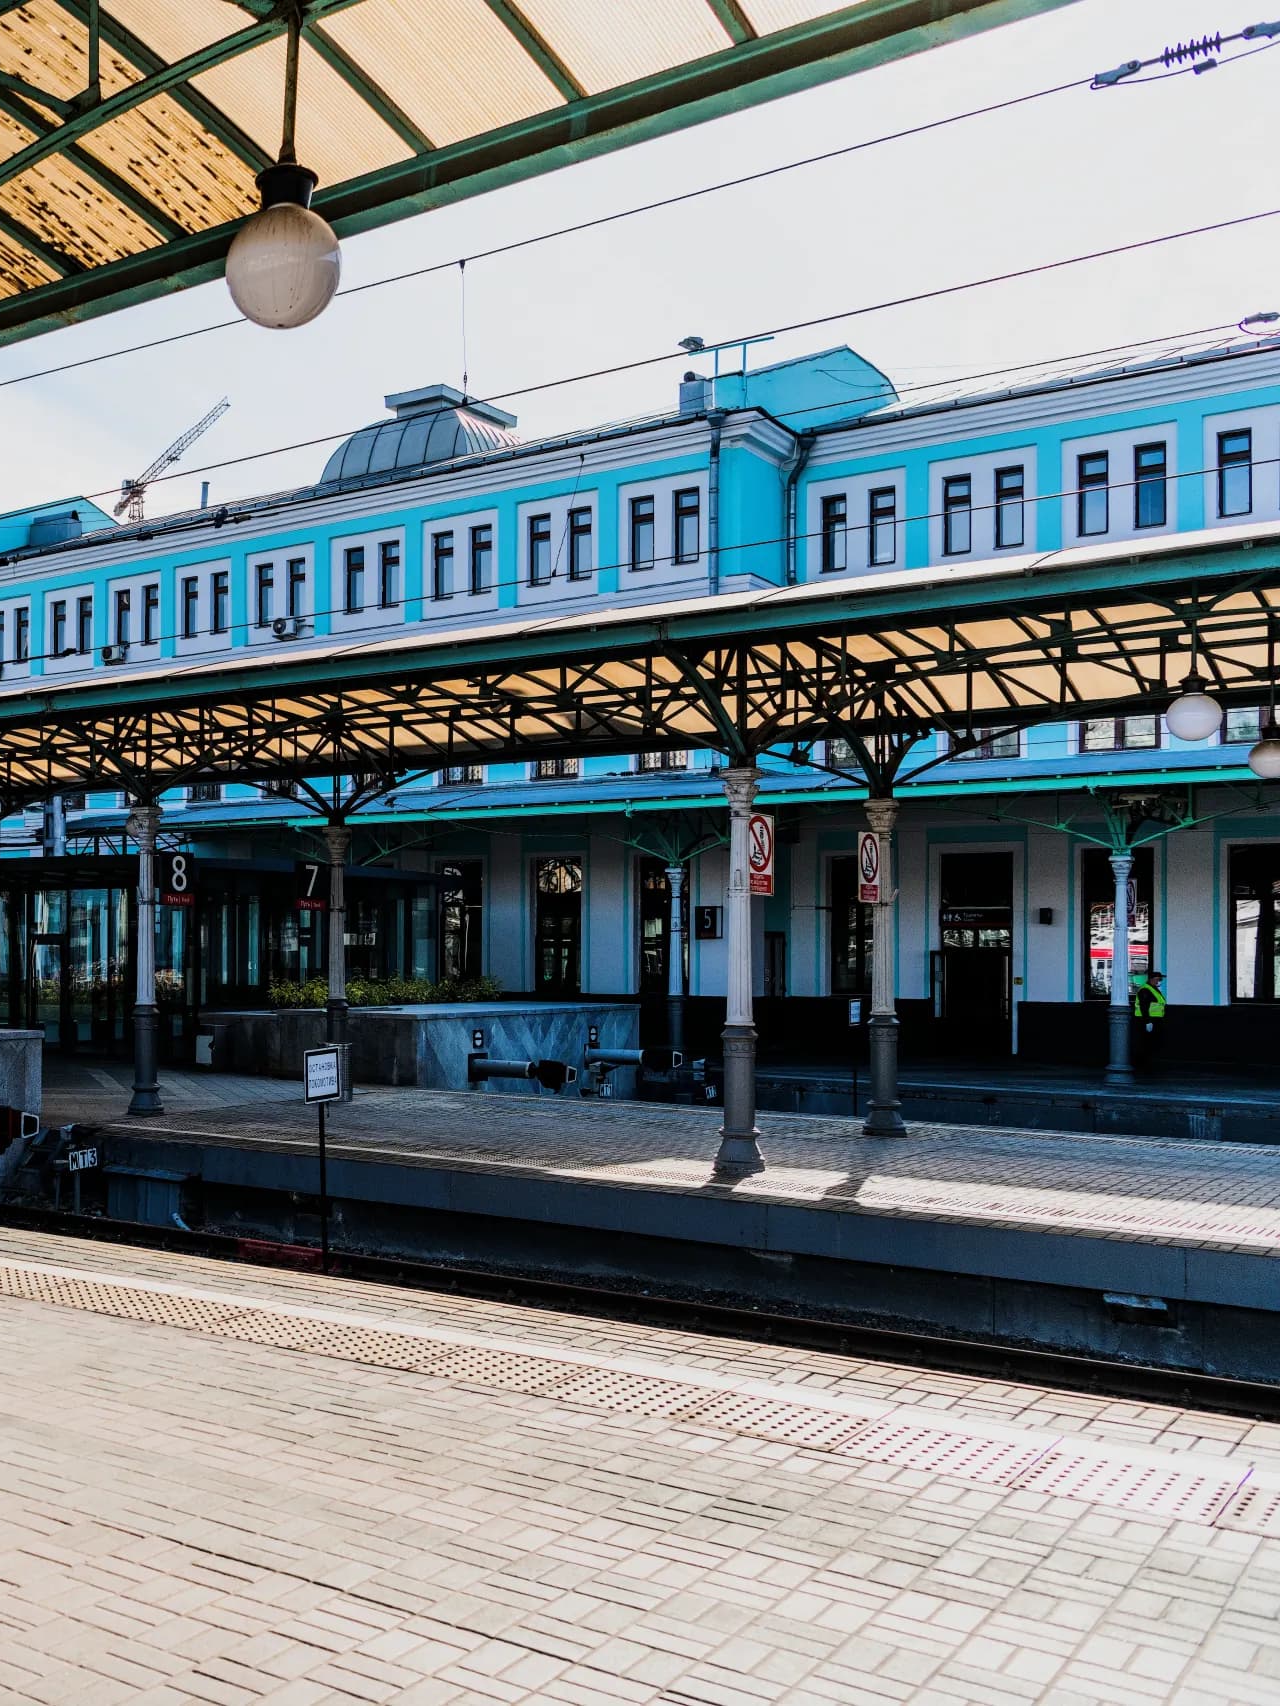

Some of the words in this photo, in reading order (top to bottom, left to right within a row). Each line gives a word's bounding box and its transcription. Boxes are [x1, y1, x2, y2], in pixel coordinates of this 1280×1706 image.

[172, 855, 187, 892] 8
[305, 864, 319, 897] 7
[704, 908, 712, 929] 5
